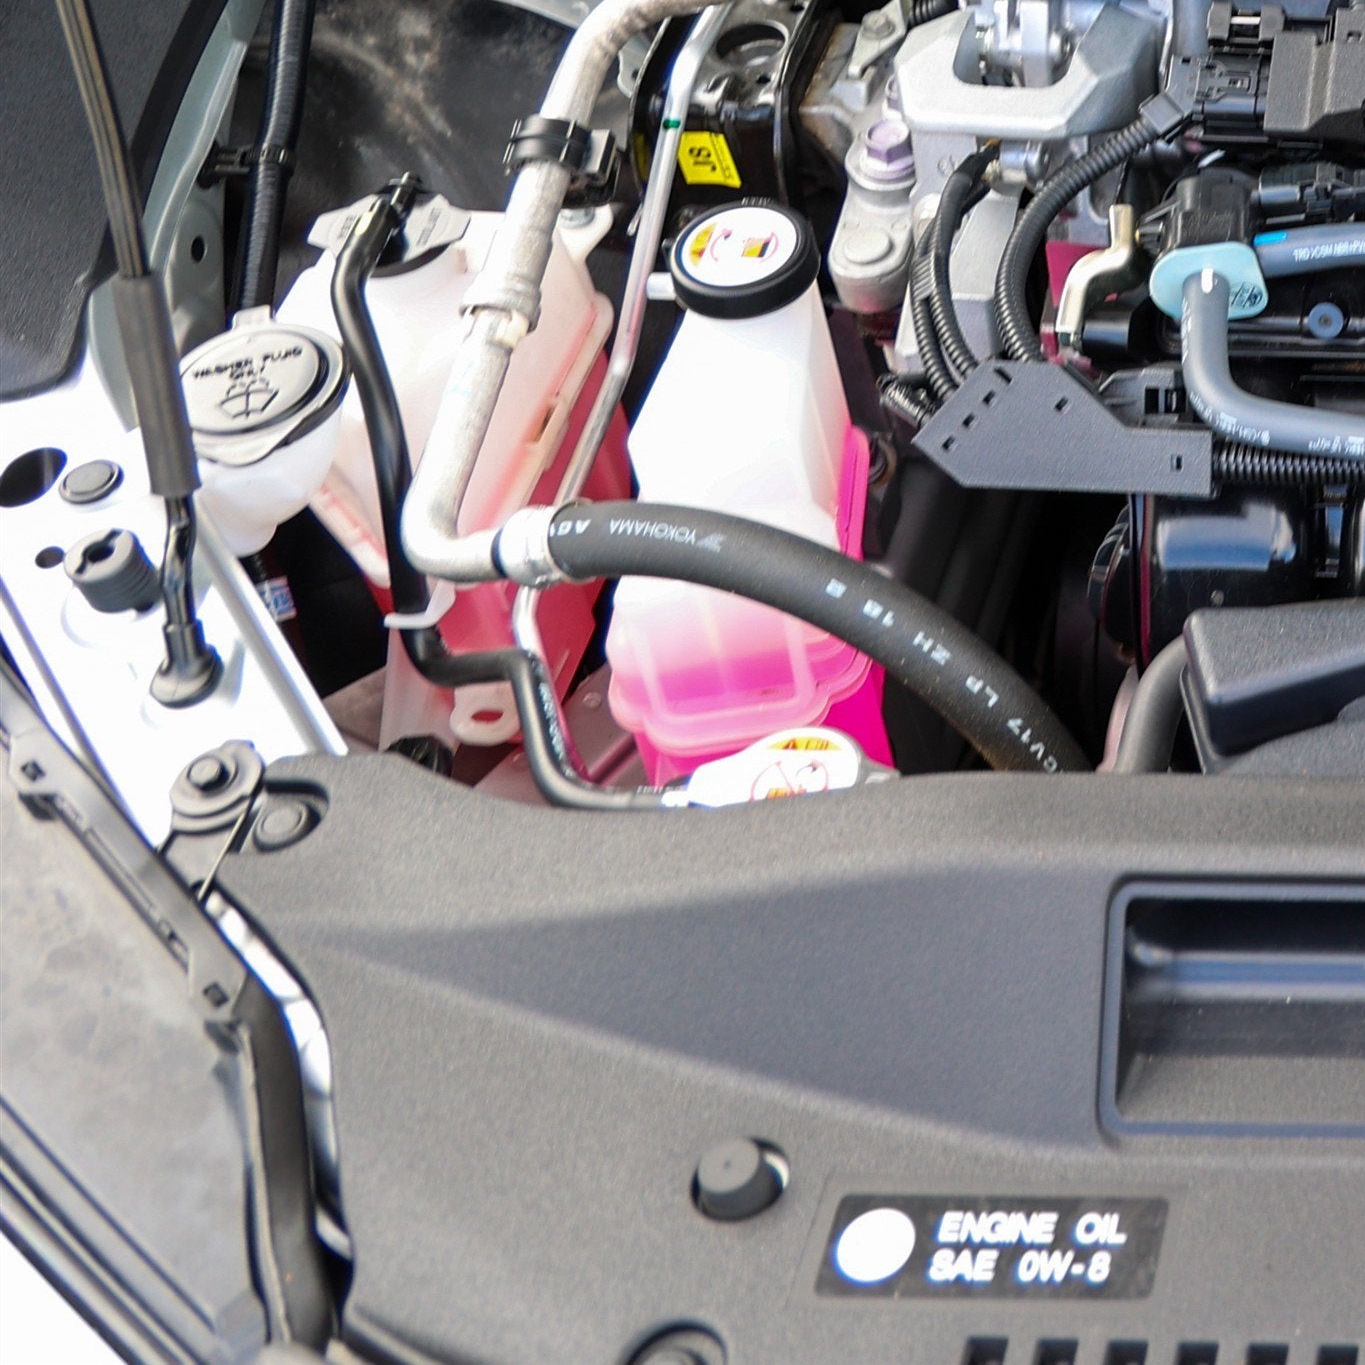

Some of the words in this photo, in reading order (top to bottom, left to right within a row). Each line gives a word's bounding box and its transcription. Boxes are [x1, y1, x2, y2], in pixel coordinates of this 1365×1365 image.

[610, 518, 697, 546] YOKOHAMA
[1007, 717, 1063, 773] CV17
[937, 1210, 1060, 1244] ENGINE
[1075, 1211, 1128, 1245] OIL
[928, 1247, 1000, 1282] SAE
[1017, 1248, 1113, 1283] 0W-8
